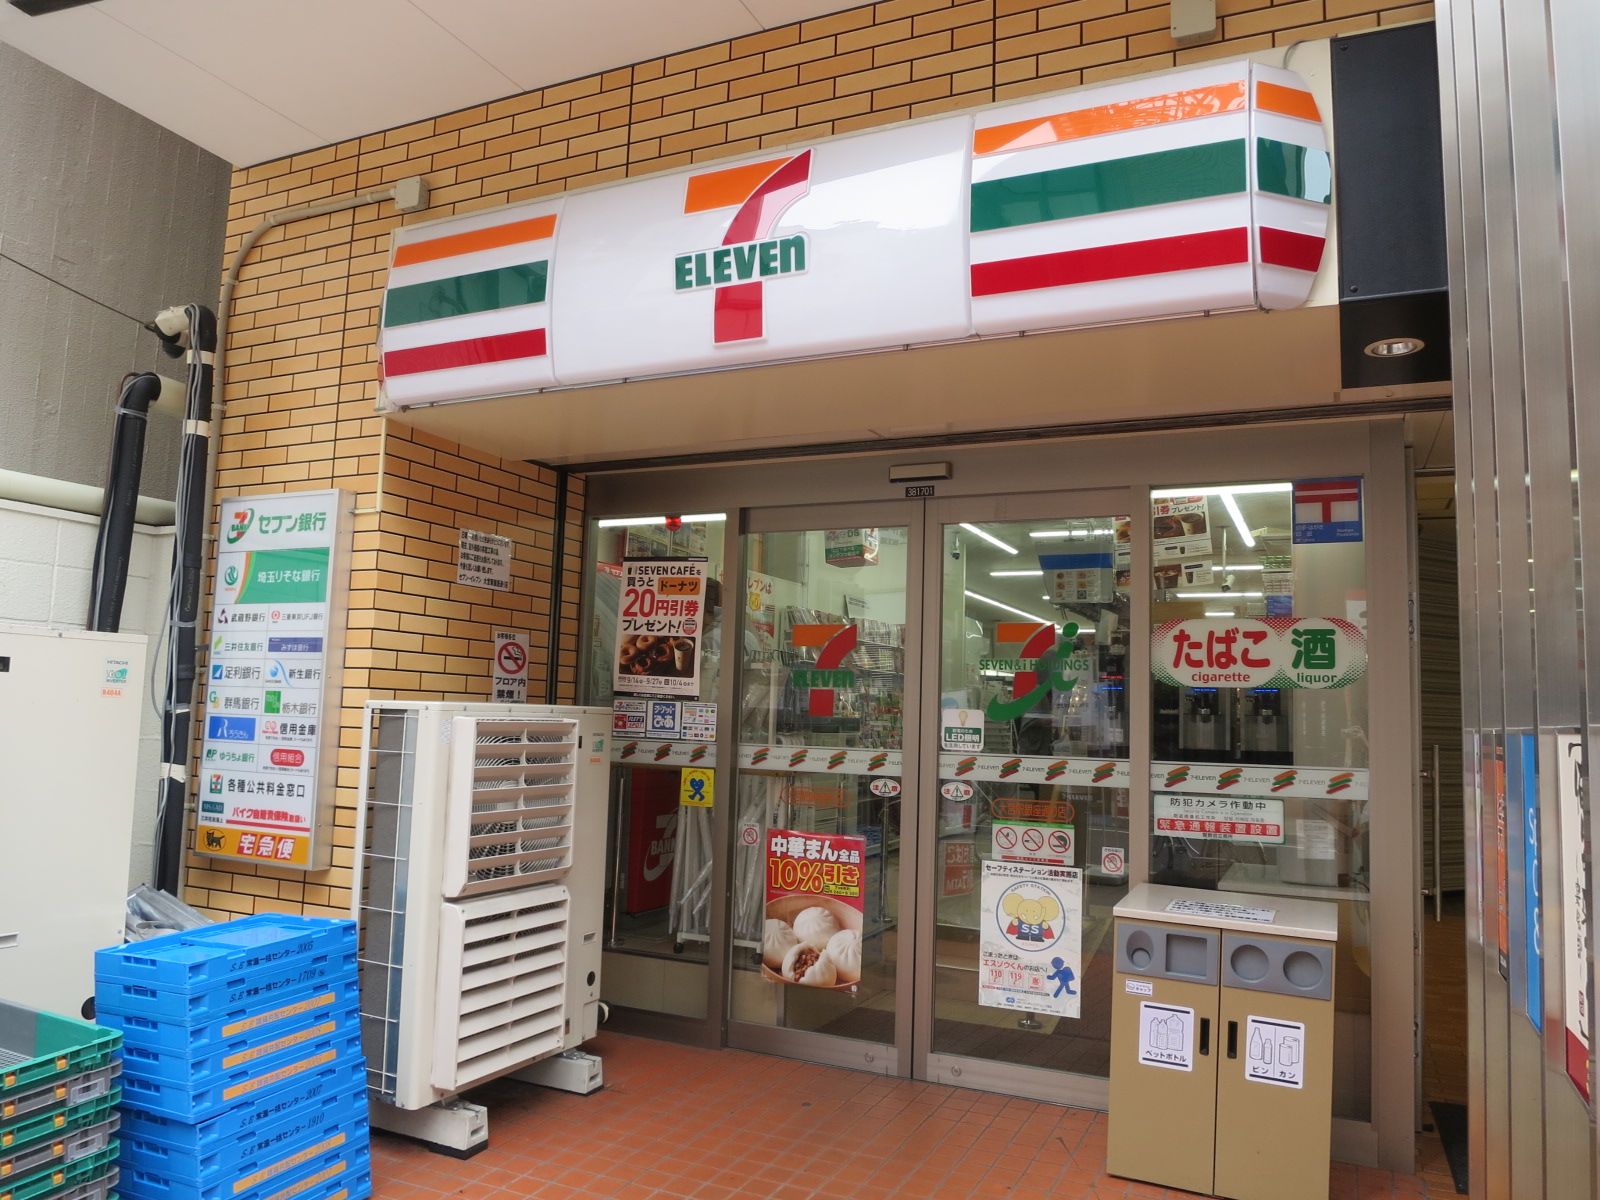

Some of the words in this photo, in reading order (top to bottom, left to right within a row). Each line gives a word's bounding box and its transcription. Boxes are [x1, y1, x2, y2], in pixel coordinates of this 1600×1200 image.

[684, 149, 813, 344] 7
[907, 487, 933, 497] 381701
[258, 512, 327, 535] セブン銀行
[257, 569, 320, 584] 埼玉りそな銀行
[638, 566, 669, 575] SEVEN
[627, 577, 654, 587] 買うと
[660, 580, 698, 592] ドーナツ
[623, 588, 699, 617] 20円引券
[230, 612, 266, 623] 武蔵野銀行
[622, 619, 682, 633] プレゼント!
[224, 642, 263, 652] 三井住友銀行
[1173, 627, 1271, 669] たばこ
[1291, 628, 1336, 670] 酒
[224, 666, 261, 681] 足利銀行
[288, 668, 321, 681] 新生銀行
[1191, 671, 1250, 683] cigarette
[1296, 672, 1337, 685] liquor
[495, 677, 527, 688] フロア内
[224, 697, 259, 711] 群馬銀行
[282, 703, 317, 716] 栃木銀行
[279, 723, 317, 736] 信用金庫
[945, 733, 980, 743] LED照明
[219, 751, 255, 763] ゆうちょ銀行
[272, 752, 302, 764] 信用組合
[228, 778, 305, 799] 各種公共料金窓口
[1170, 797, 1266, 811] 防犯カメラ作動中
[1159, 819, 1278, 835] 緊急通報装置設置
[240, 833, 295, 860] 宅急便
[771, 835, 860, 863] 中華まん全品
[769, 858, 860, 893] 10%引き
[985, 864, 1079, 879] セーフティステーション活動実施店
[1021, 924, 1040, 934] SS
[1145, 1049, 1187, 1063] ペットボトル
[1252, 1066, 1269, 1075] ビン
[1279, 1070, 1296, 1079] カン
